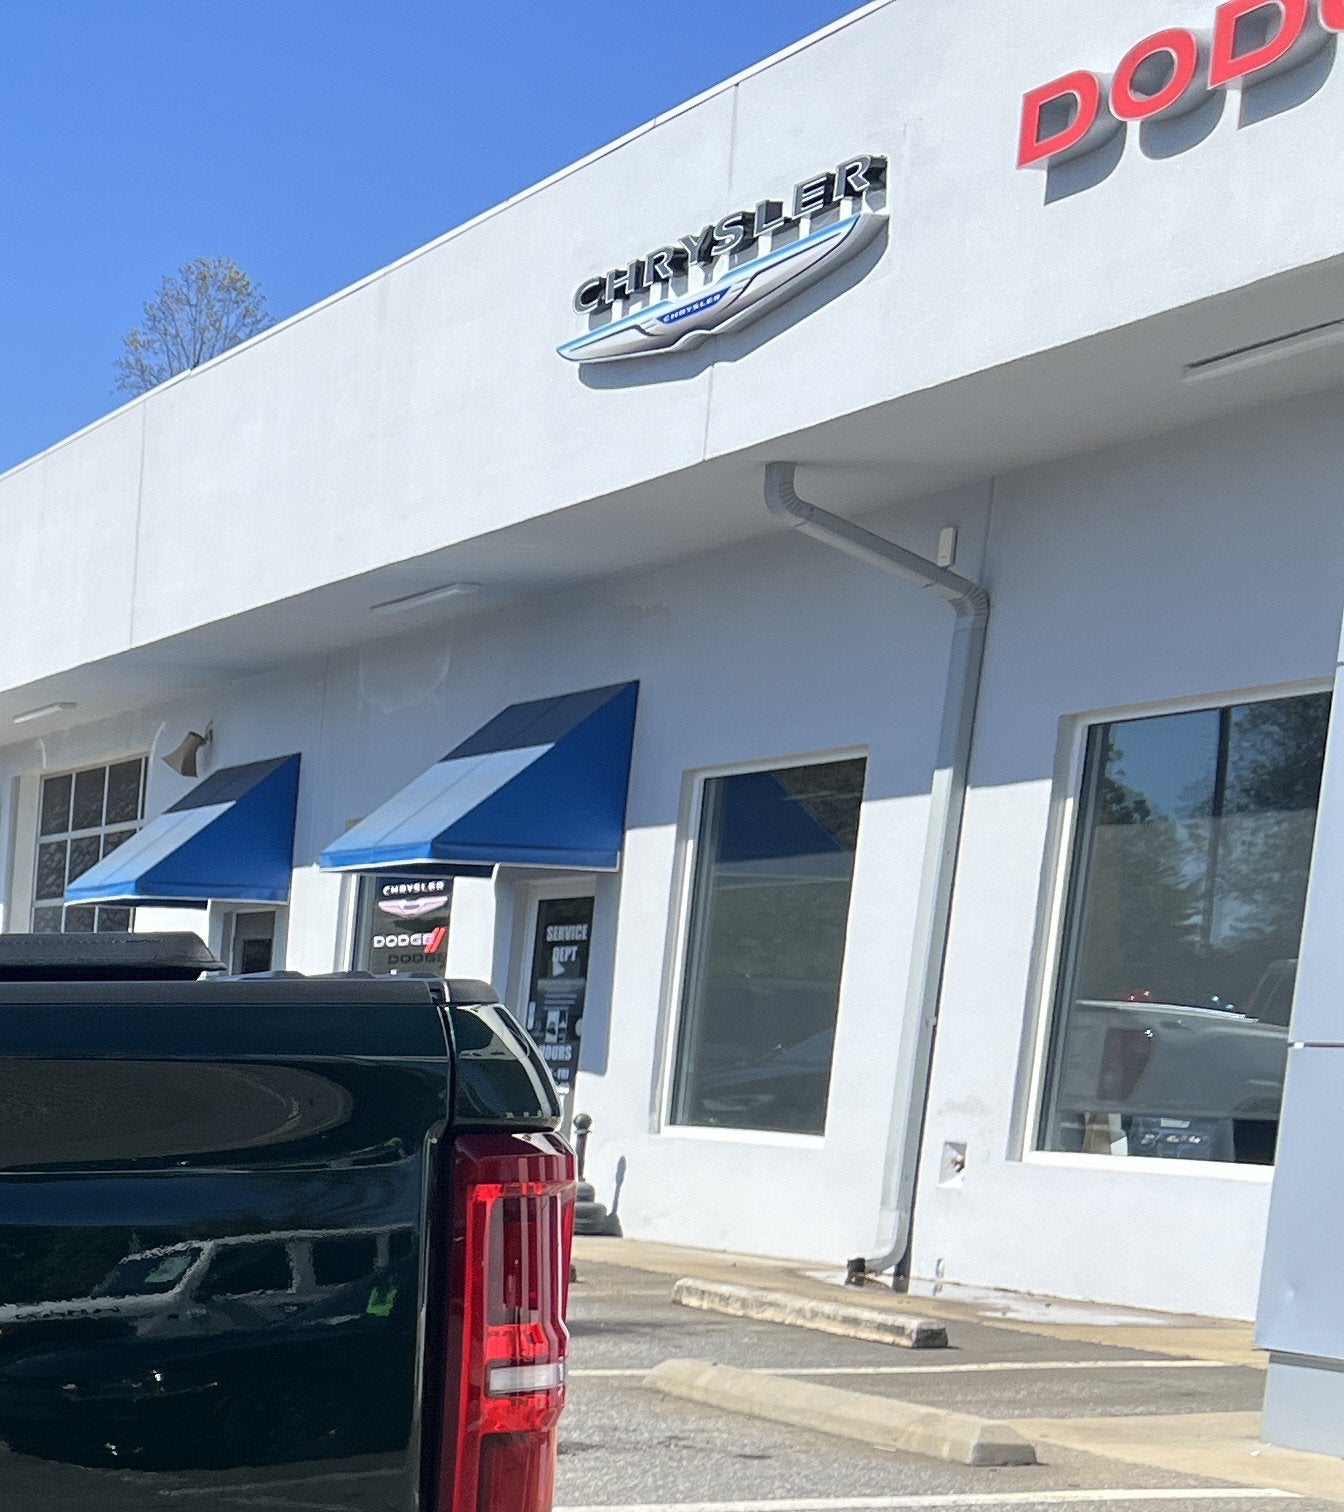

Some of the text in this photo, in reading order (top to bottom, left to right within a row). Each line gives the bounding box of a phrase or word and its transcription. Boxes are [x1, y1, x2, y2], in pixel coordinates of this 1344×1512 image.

[1015, 0, 1344, 169] DOD
[572, 154, 874, 314] CHRYSLER
[383, 881, 445, 896] CHRYSLER
[373, 932, 434, 948] DODGE
[546, 923, 589, 942] SERVICE
